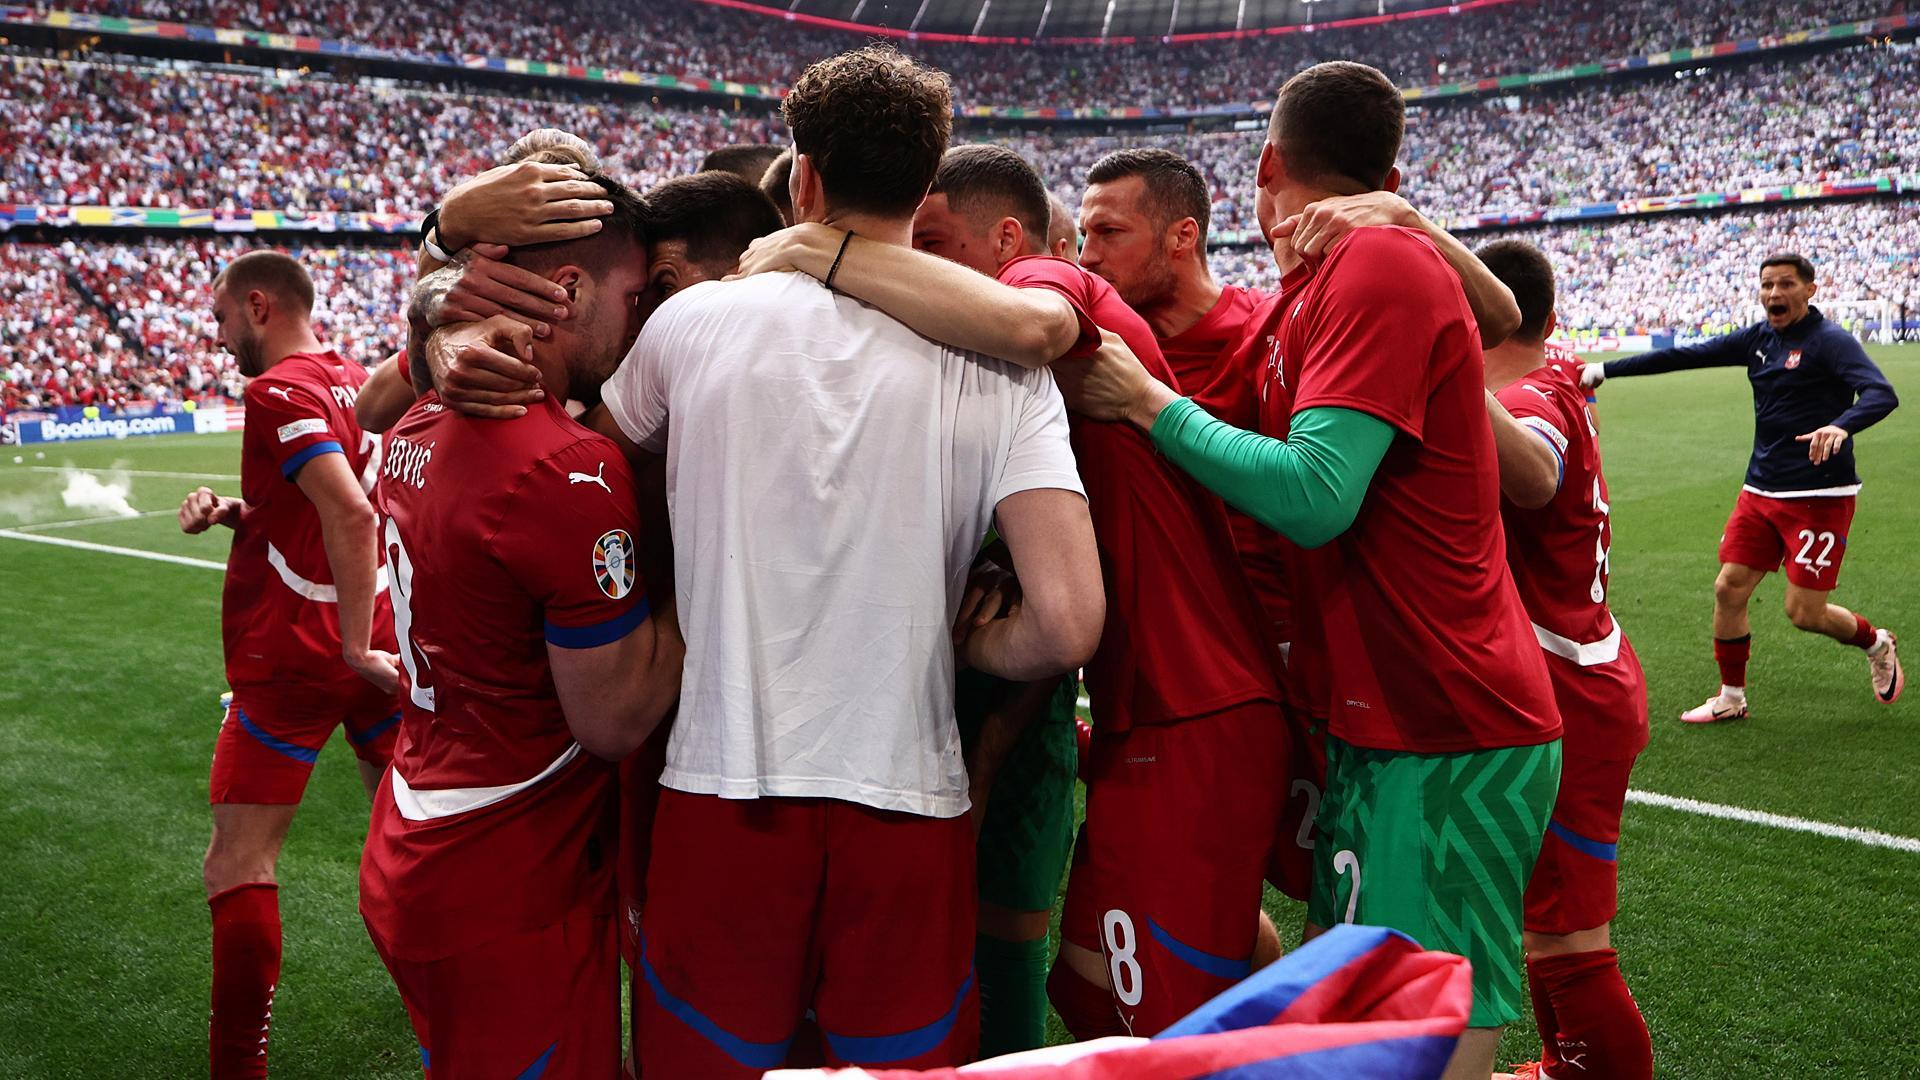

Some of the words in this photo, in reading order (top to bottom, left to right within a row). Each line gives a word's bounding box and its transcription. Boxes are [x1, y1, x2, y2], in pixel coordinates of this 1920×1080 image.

[41, 416, 176, 440] Booking.com
[384, 437, 436, 489] JOVIĆ
[1795, 529, 1835, 567] 22
[1103, 909, 1143, 1006] 8
